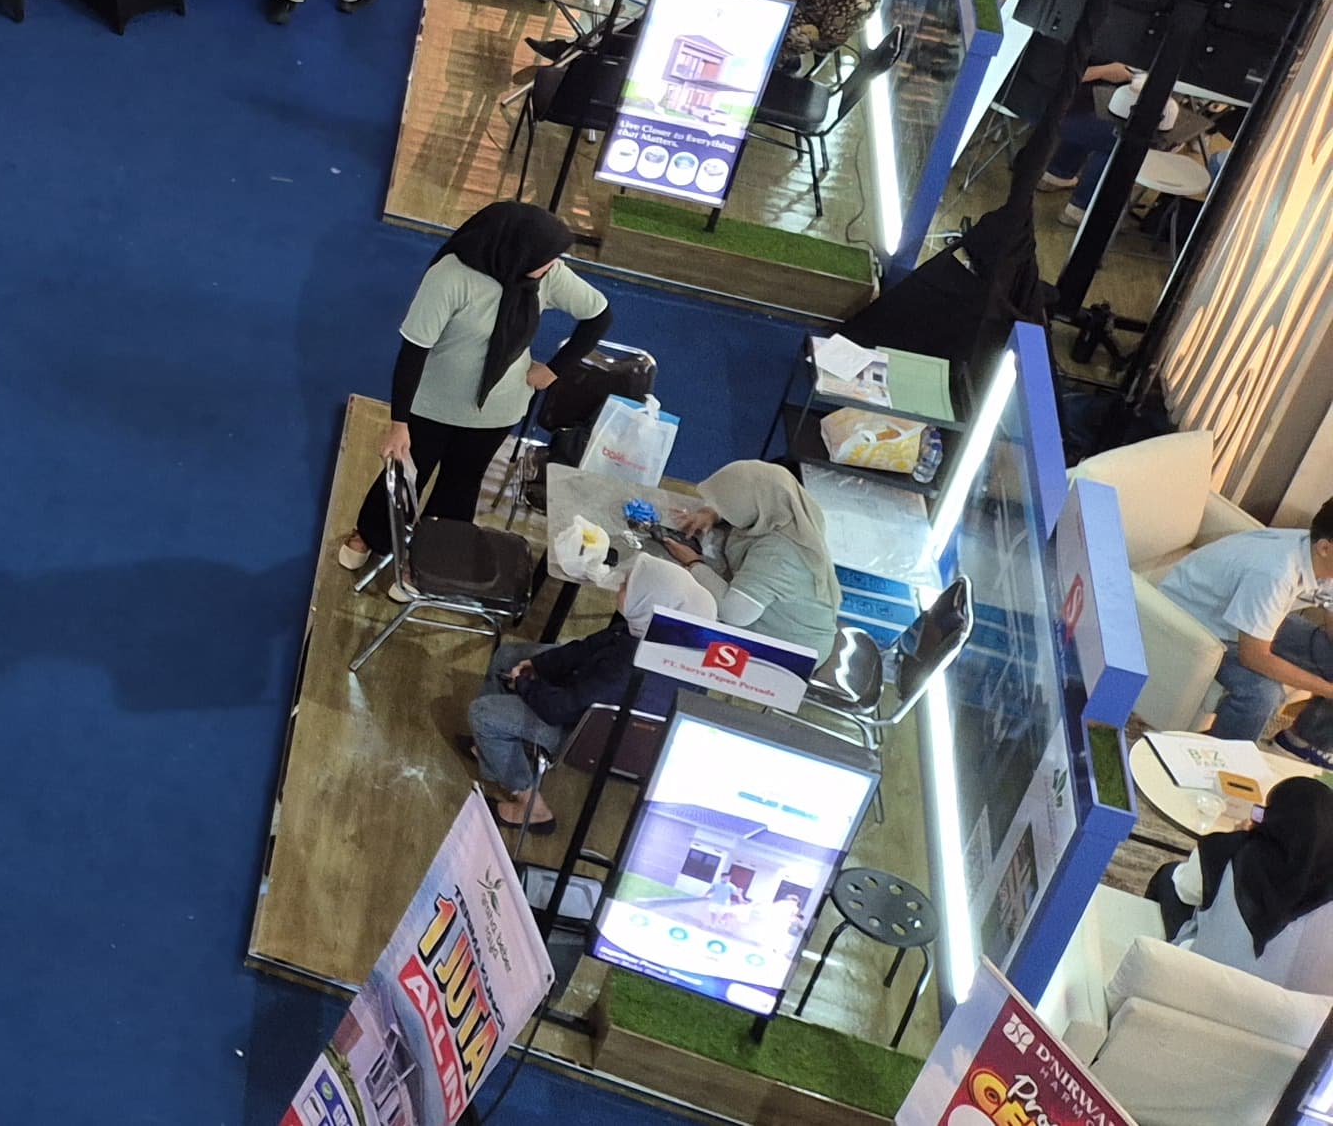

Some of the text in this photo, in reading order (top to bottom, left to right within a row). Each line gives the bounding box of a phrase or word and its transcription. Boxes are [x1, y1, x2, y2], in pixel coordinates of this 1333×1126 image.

[641, 124, 672, 138] Closer
[685, 134, 736, 154] Everything
[714, 645, 740, 667] S
[739, 680, 776, 697] Persada
[418, 893, 499, 1099] 1 JUTA
[454, 884, 505, 1031] TERIMA KUNCI
[406, 974, 465, 1122] ALL IN
